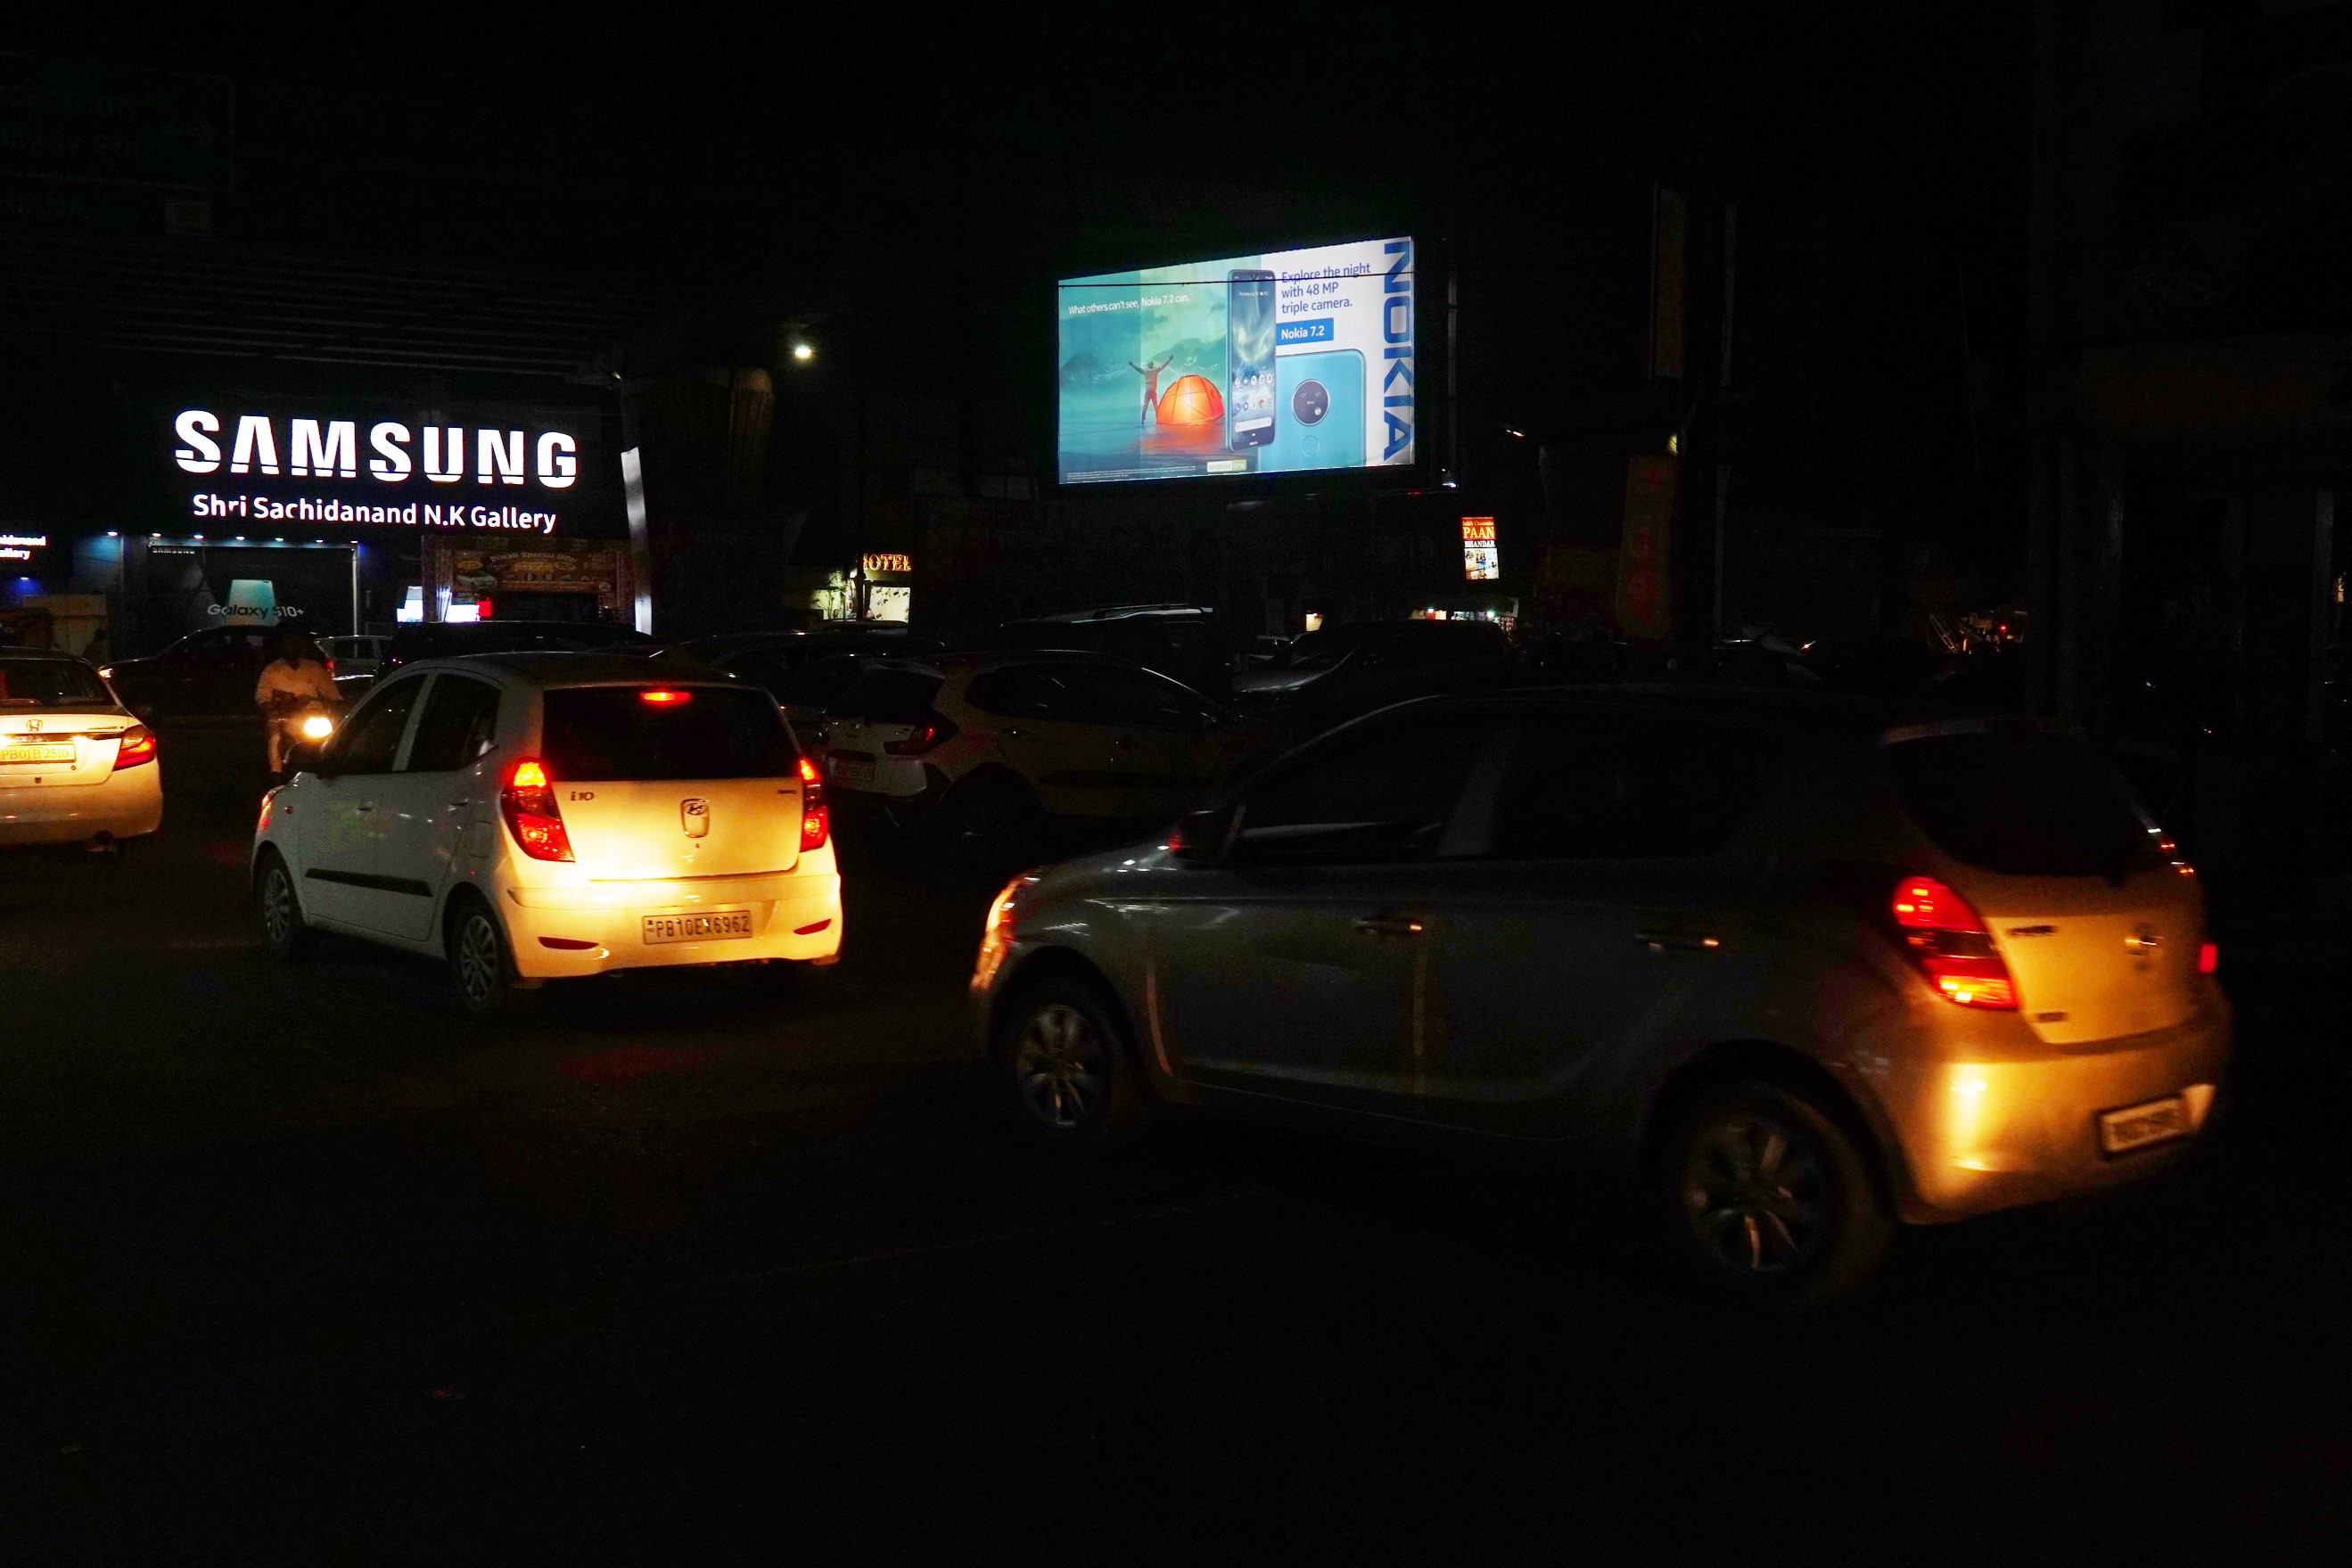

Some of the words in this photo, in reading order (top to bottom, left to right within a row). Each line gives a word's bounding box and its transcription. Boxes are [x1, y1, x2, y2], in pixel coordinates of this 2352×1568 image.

[1281, 269, 1320, 285] Explore
[1323, 266, 1340, 278] the
[1343, 262, 1371, 278] night
[1281, 283, 1303, 299] with
[1306, 283, 1320, 296] 48
[1322, 281, 1339, 294] MP
[1068, 305, 1086, 315] What
[1086, 302, 1108, 313] others
[1108, 300, 1125, 310] can't
[1125, 300, 1140, 309] see,
[1141, 296, 1162, 307] Nokia
[1163, 294, 1174, 304] 7.2
[1175, 293, 1190, 303] can.
[1281, 299, 1309, 316] triple
[1311, 298, 1353, 311] camera.
[1281, 325, 1308, 341] Nokia
[1310, 324, 1325, 339] 7.2
[1384, 242, 1412, 462] NOKIA
[175, 410, 577, 488] SAMSUNG
[193, 493, 247, 518] Shri
[253, 497, 417, 526] Sachidanand
[424, 504, 466, 527] N.K
[470, 505, 557, 535] Gallery
[1462, 526, 1495, 539] PAAN
[1464, 540, 1496, 548] BHANDAR
[207, 603, 267, 620] Galaxy
